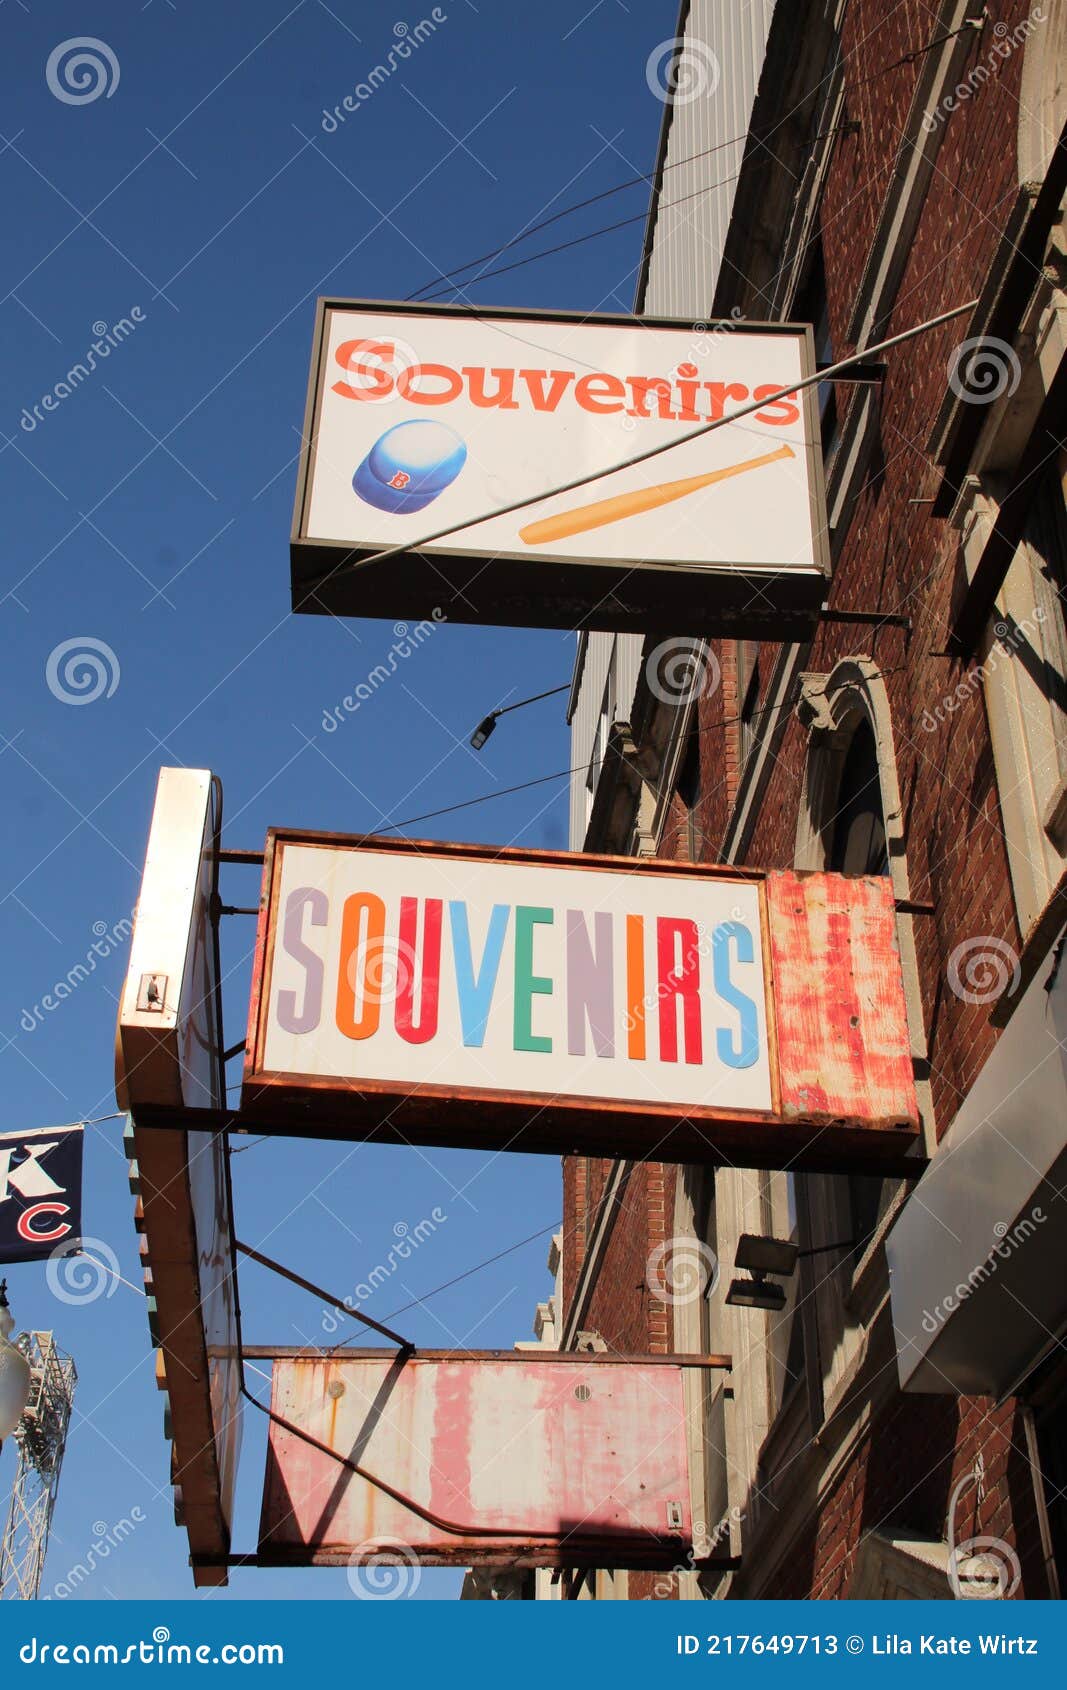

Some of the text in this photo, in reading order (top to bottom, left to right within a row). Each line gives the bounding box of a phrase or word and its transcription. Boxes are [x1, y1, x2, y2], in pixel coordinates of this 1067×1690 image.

[331, 338, 801, 426] Souvenirs
[386, 470, 411, 490] B
[276, 886, 760, 1069] SOUVENIRS
[17, 1202, 73, 1242] C
